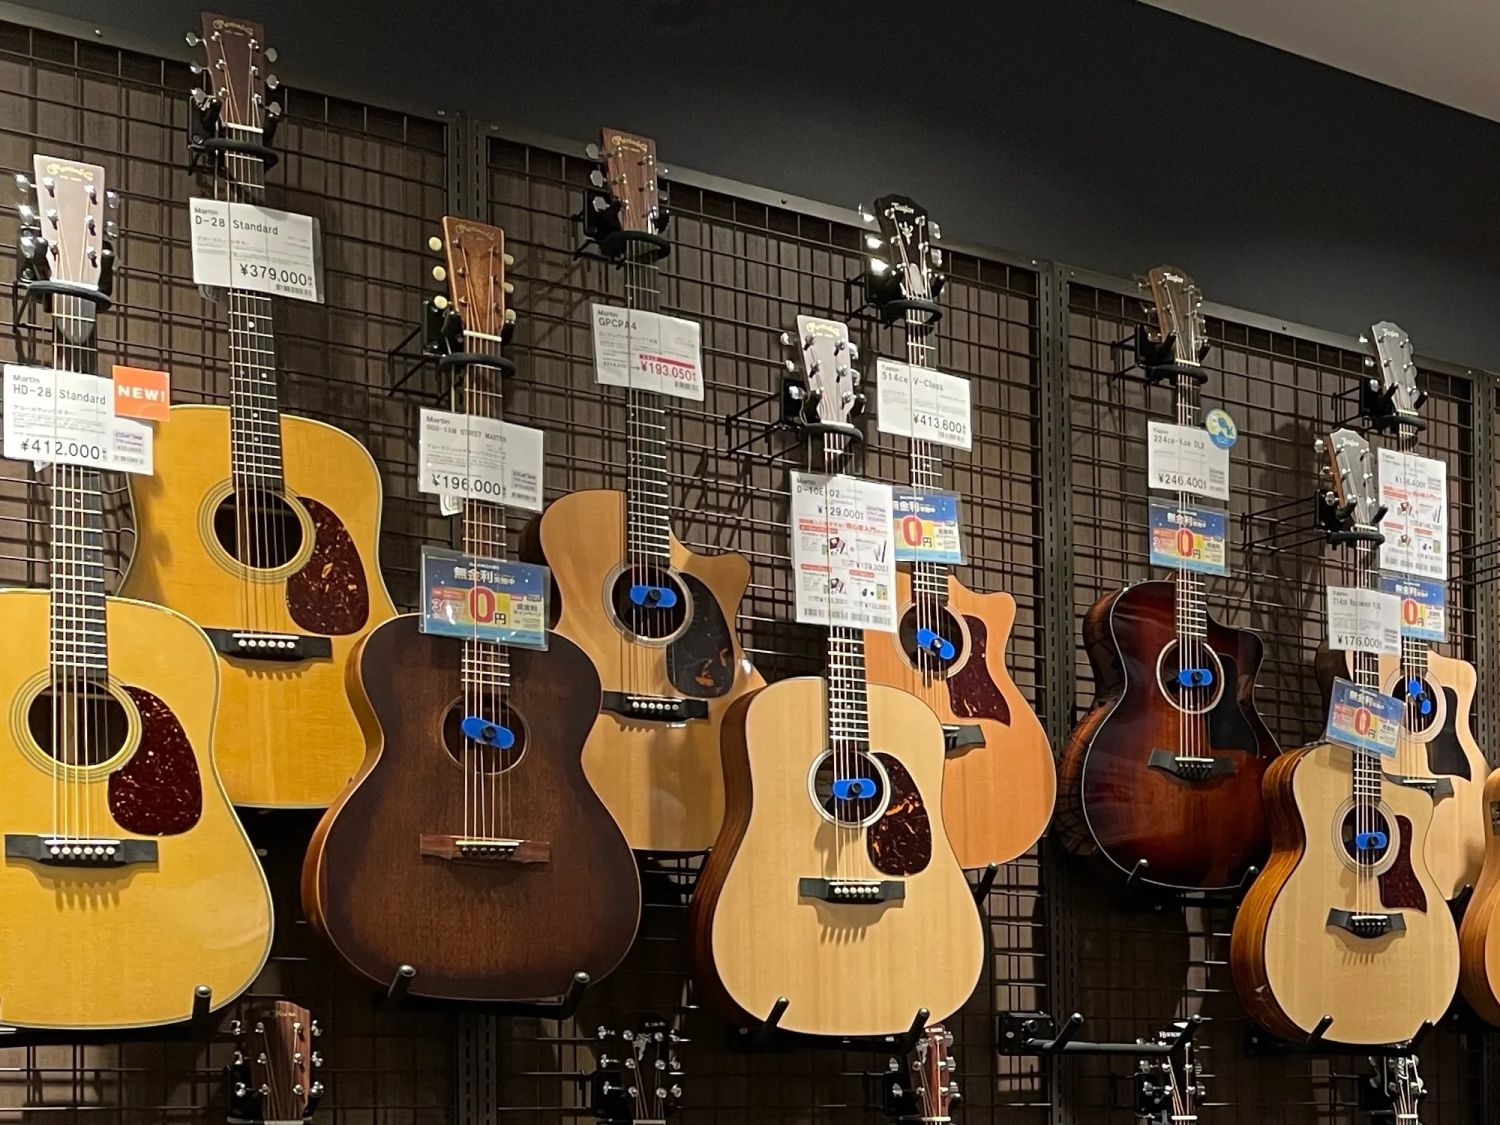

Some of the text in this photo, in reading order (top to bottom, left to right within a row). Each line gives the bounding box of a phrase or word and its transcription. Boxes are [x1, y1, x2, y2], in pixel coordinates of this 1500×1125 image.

[195, 215, 278, 235] D-28 Standard
[599, 317, 637, 330] GPCPA4
[13, 374, 40, 384] Martin
[913, 377, 944, 392] V-Class
[13, 384, 106, 405] HD-28 Standard
[117, 384, 166, 402] NEW!
